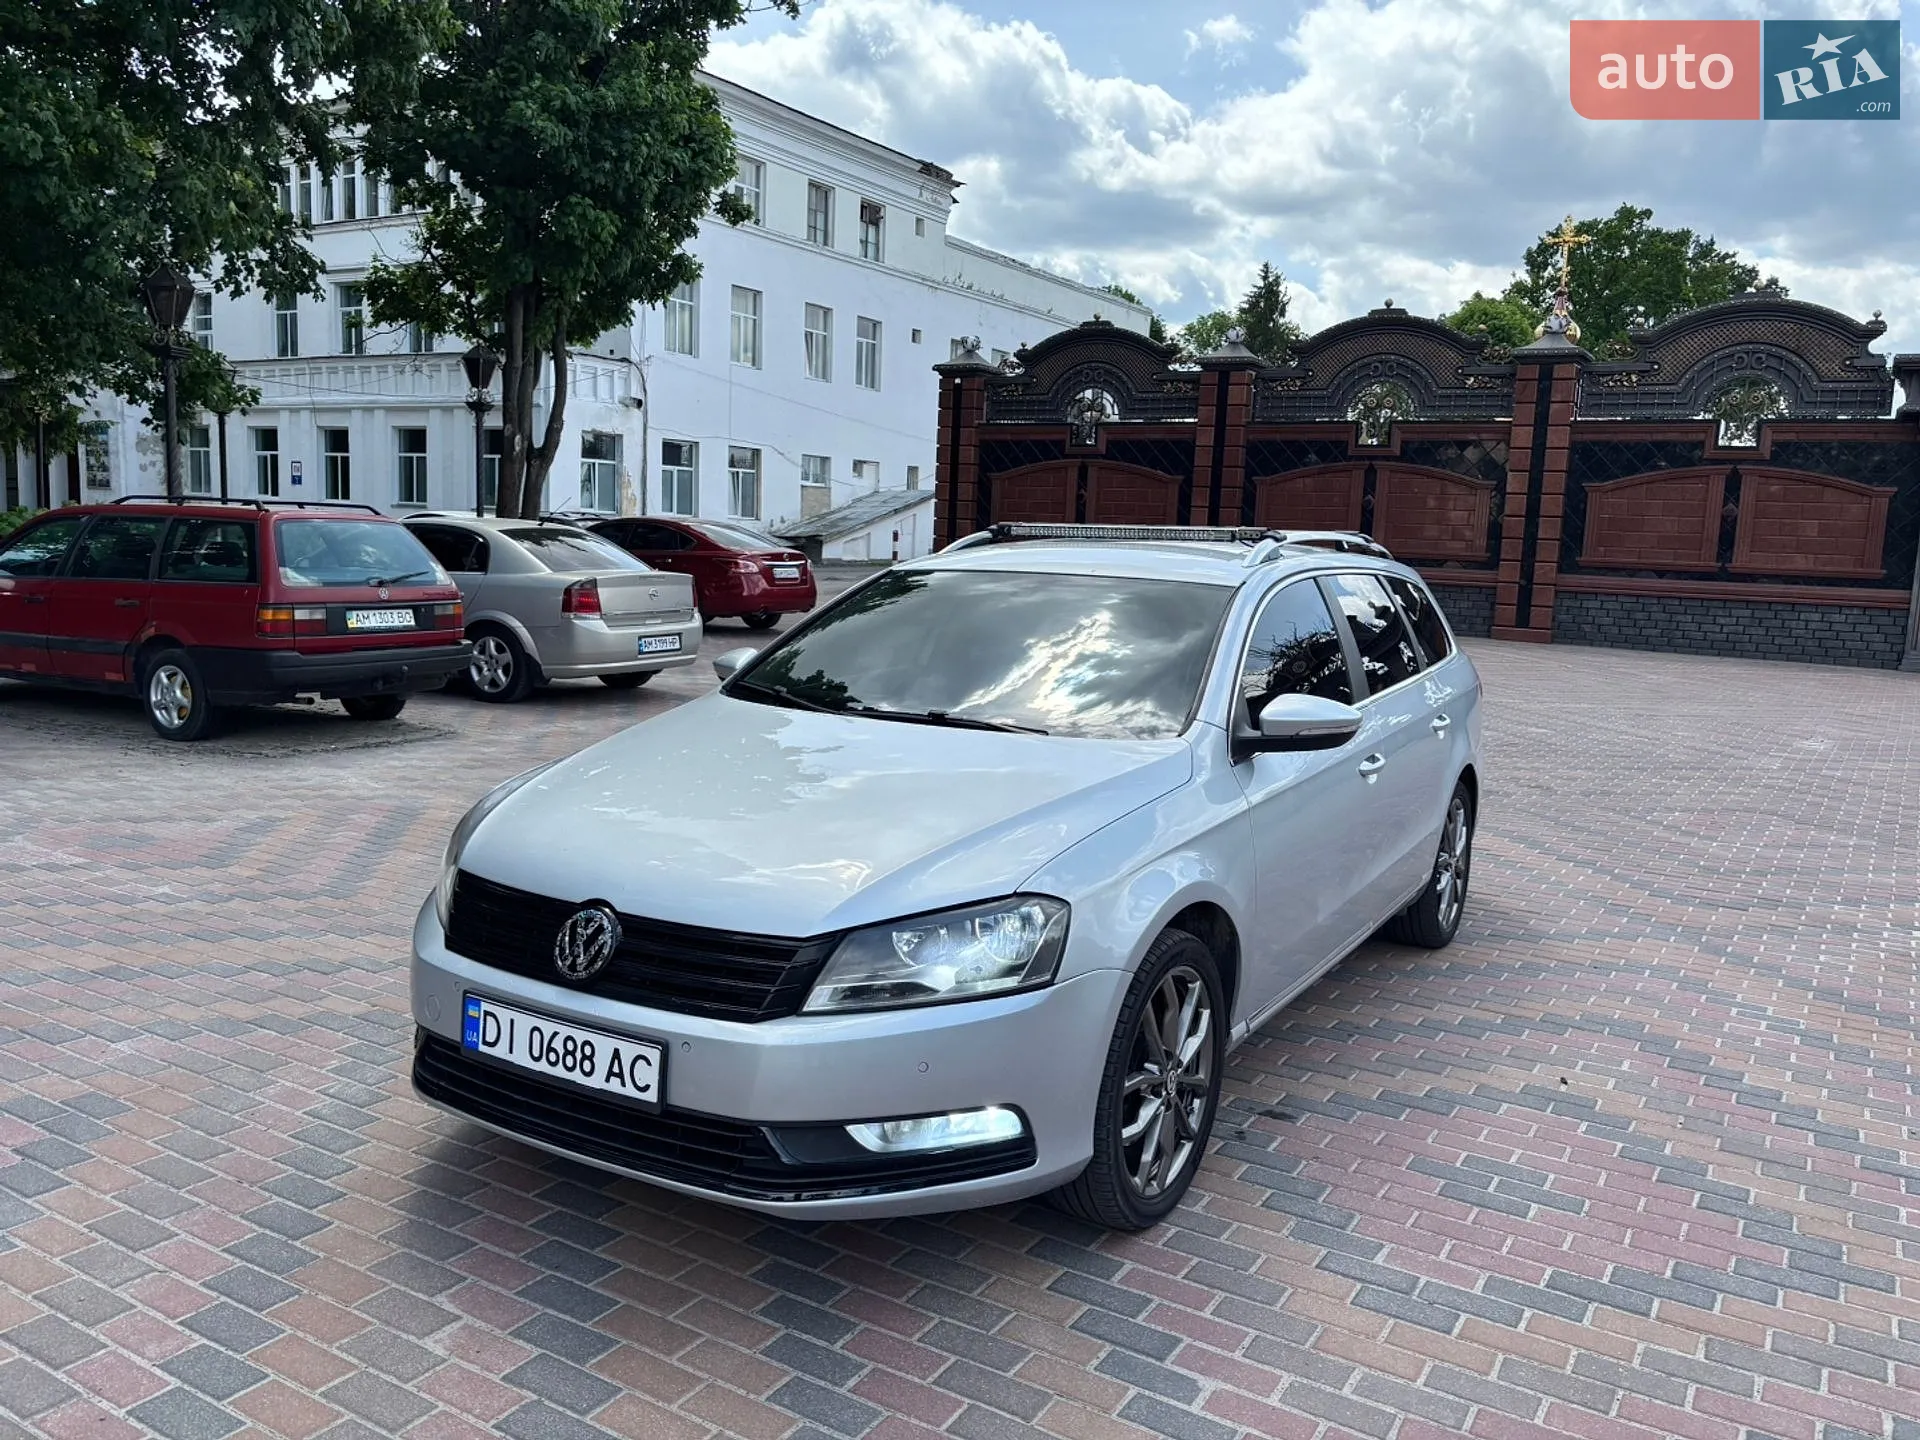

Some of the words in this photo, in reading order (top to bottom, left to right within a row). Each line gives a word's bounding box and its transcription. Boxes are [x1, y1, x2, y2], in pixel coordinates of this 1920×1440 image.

[355, 612, 371, 625] AM
[372, 611, 395, 624] 1303
[481, 1009, 515, 1055] DI
[528, 1025, 596, 1078] 0688
[604, 1047, 653, 1093] AC
